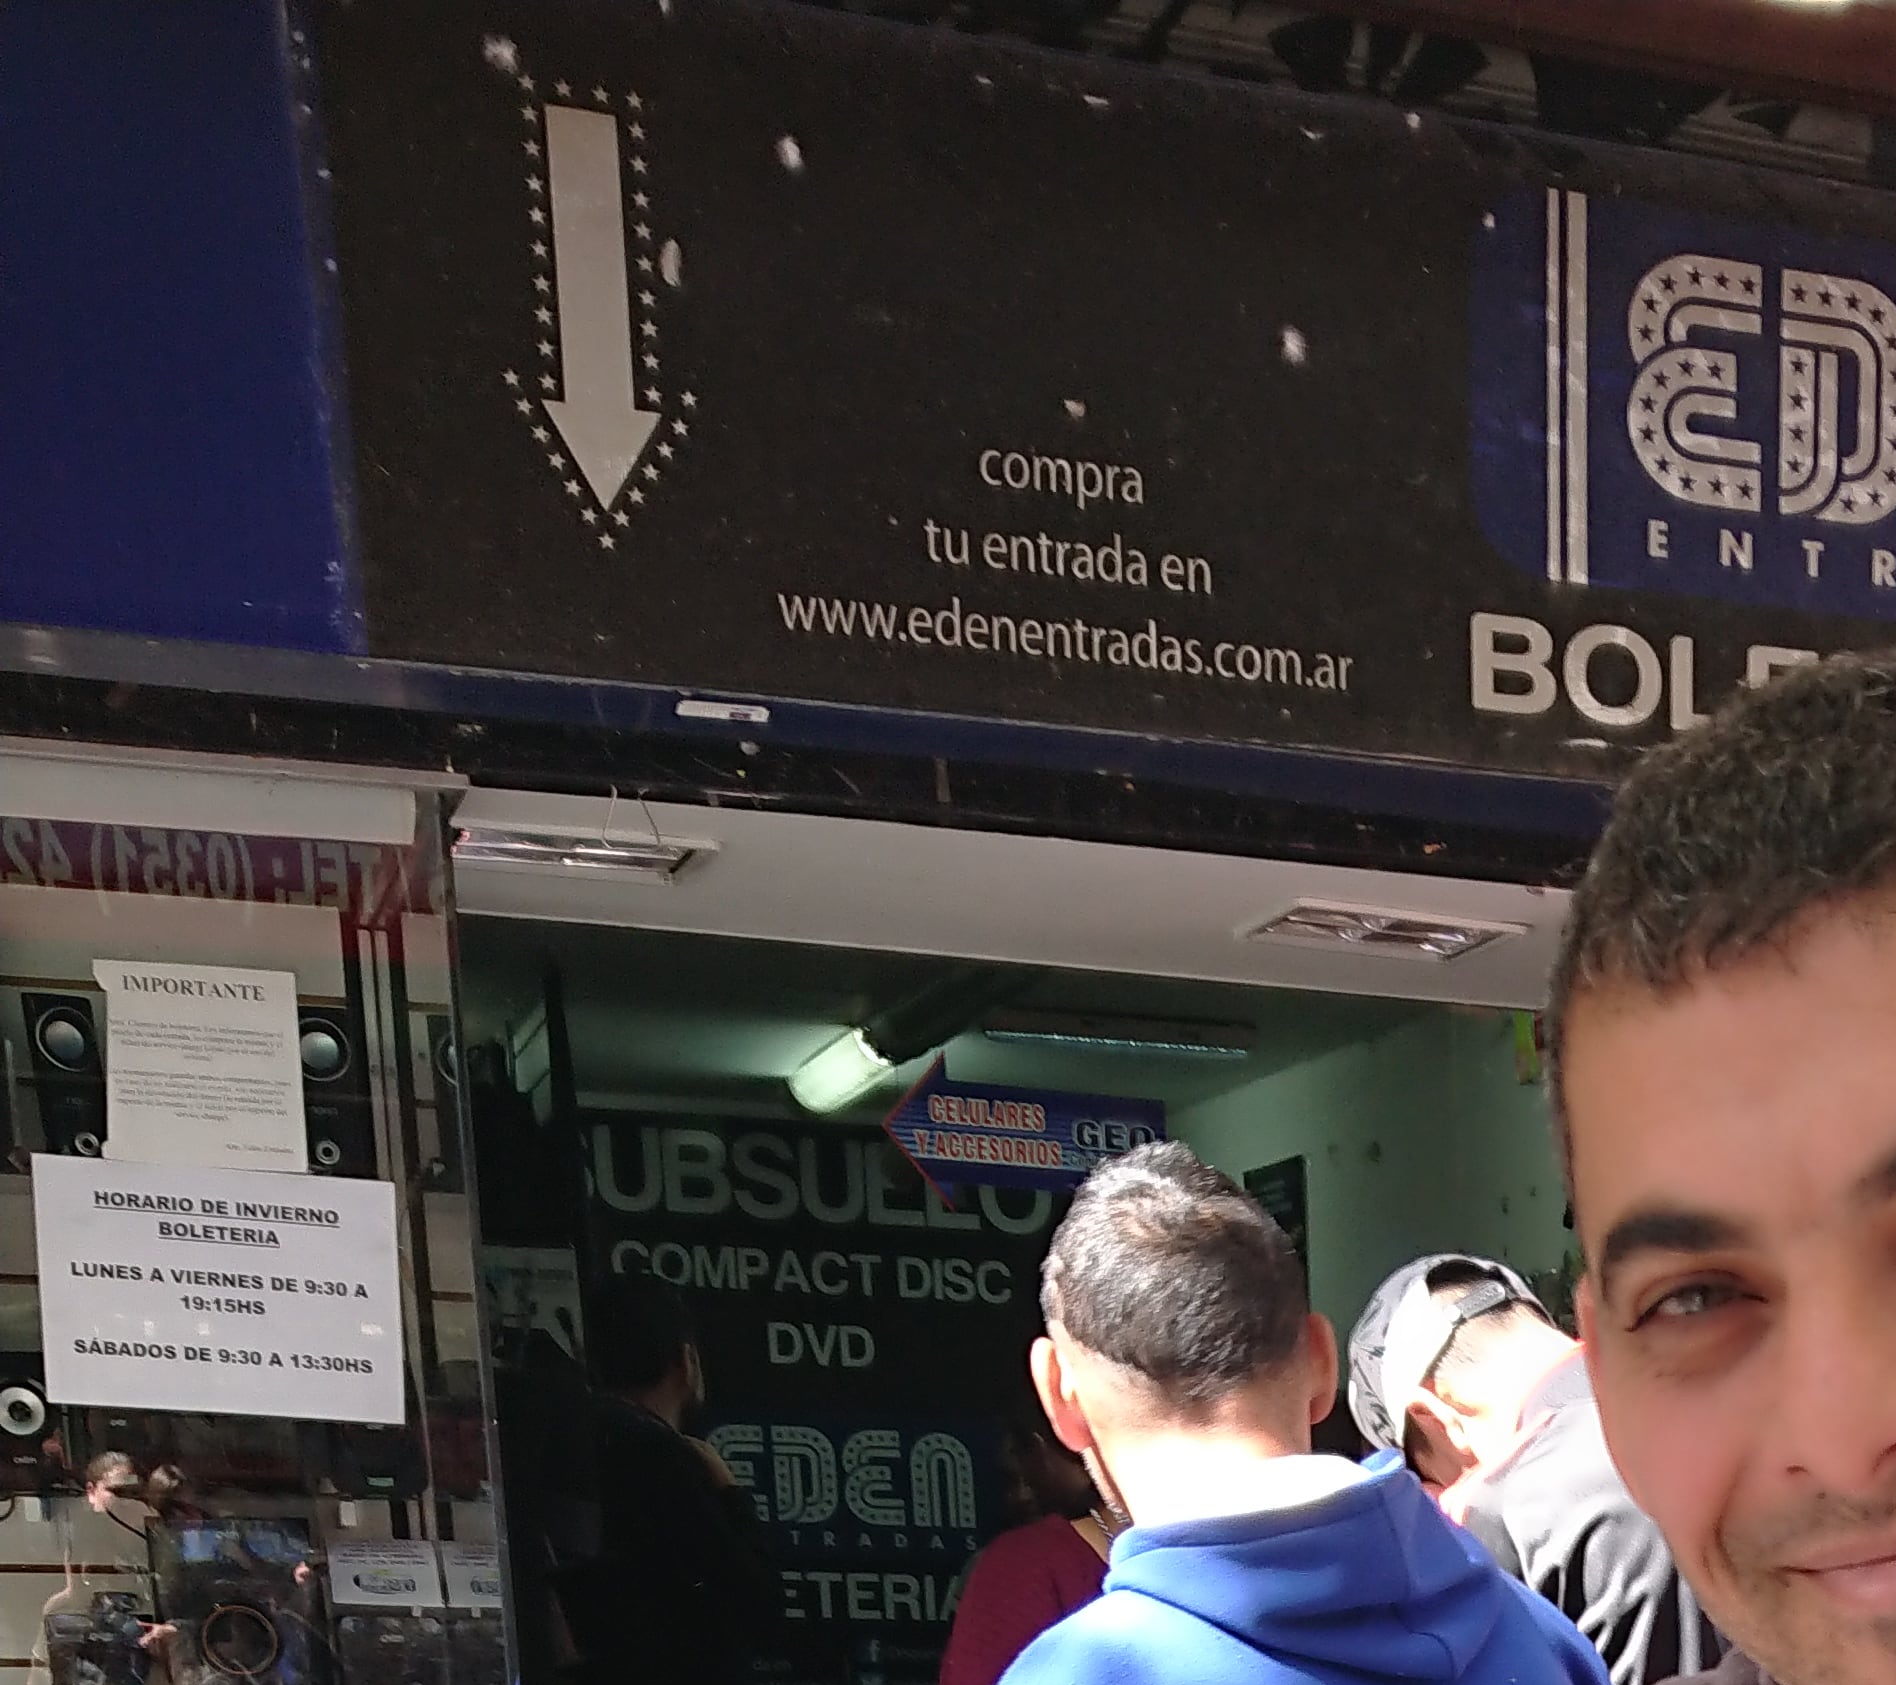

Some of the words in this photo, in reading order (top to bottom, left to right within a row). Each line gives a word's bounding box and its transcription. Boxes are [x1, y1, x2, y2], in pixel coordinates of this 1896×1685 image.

[979, 448, 1144, 510] compra
[924, 517, 969, 565] tu
[982, 528, 1148, 587] entrada
[1159, 552, 1212, 595] en
[777, 592, 1354, 692] www.edenentradas.com.ar
[122, 974, 266, 1001] IMPORTANTE
[928, 1094, 1046, 1132] CELULARES
[913, 1129, 930, 1156] Y
[935, 1130, 1063, 1168] ACCESORIOS
[93, 1191, 194, 1214] HORARIO
[200, 1199, 229, 1217] DE
[235, 1202, 340, 1225] INVIERNO
[158, 1222, 280, 1246] BOLETERIA
[70, 1262, 143, 1281] LUNES
[149, 1268, 165, 1283] A
[170, 1269, 263, 1291] VIERNES
[271, 1277, 299, 1293] DE
[304, 1280, 348, 1297] 9:30
[354, 1284, 369, 1299] A
[611, 1240, 882, 1297] COMPACT
[897, 1256, 1013, 1304] DISC
[180, 1295, 267, 1316] 19:15HS
[74, 1337, 177, 1360] SÁBADOS
[184, 1346, 213, 1363] DE
[218, 1349, 262, 1367] 9:30
[268, 1354, 284, 1368] A
[290, 1354, 374, 1375] 13:30HS
[767, 1321, 876, 1368] DVD
